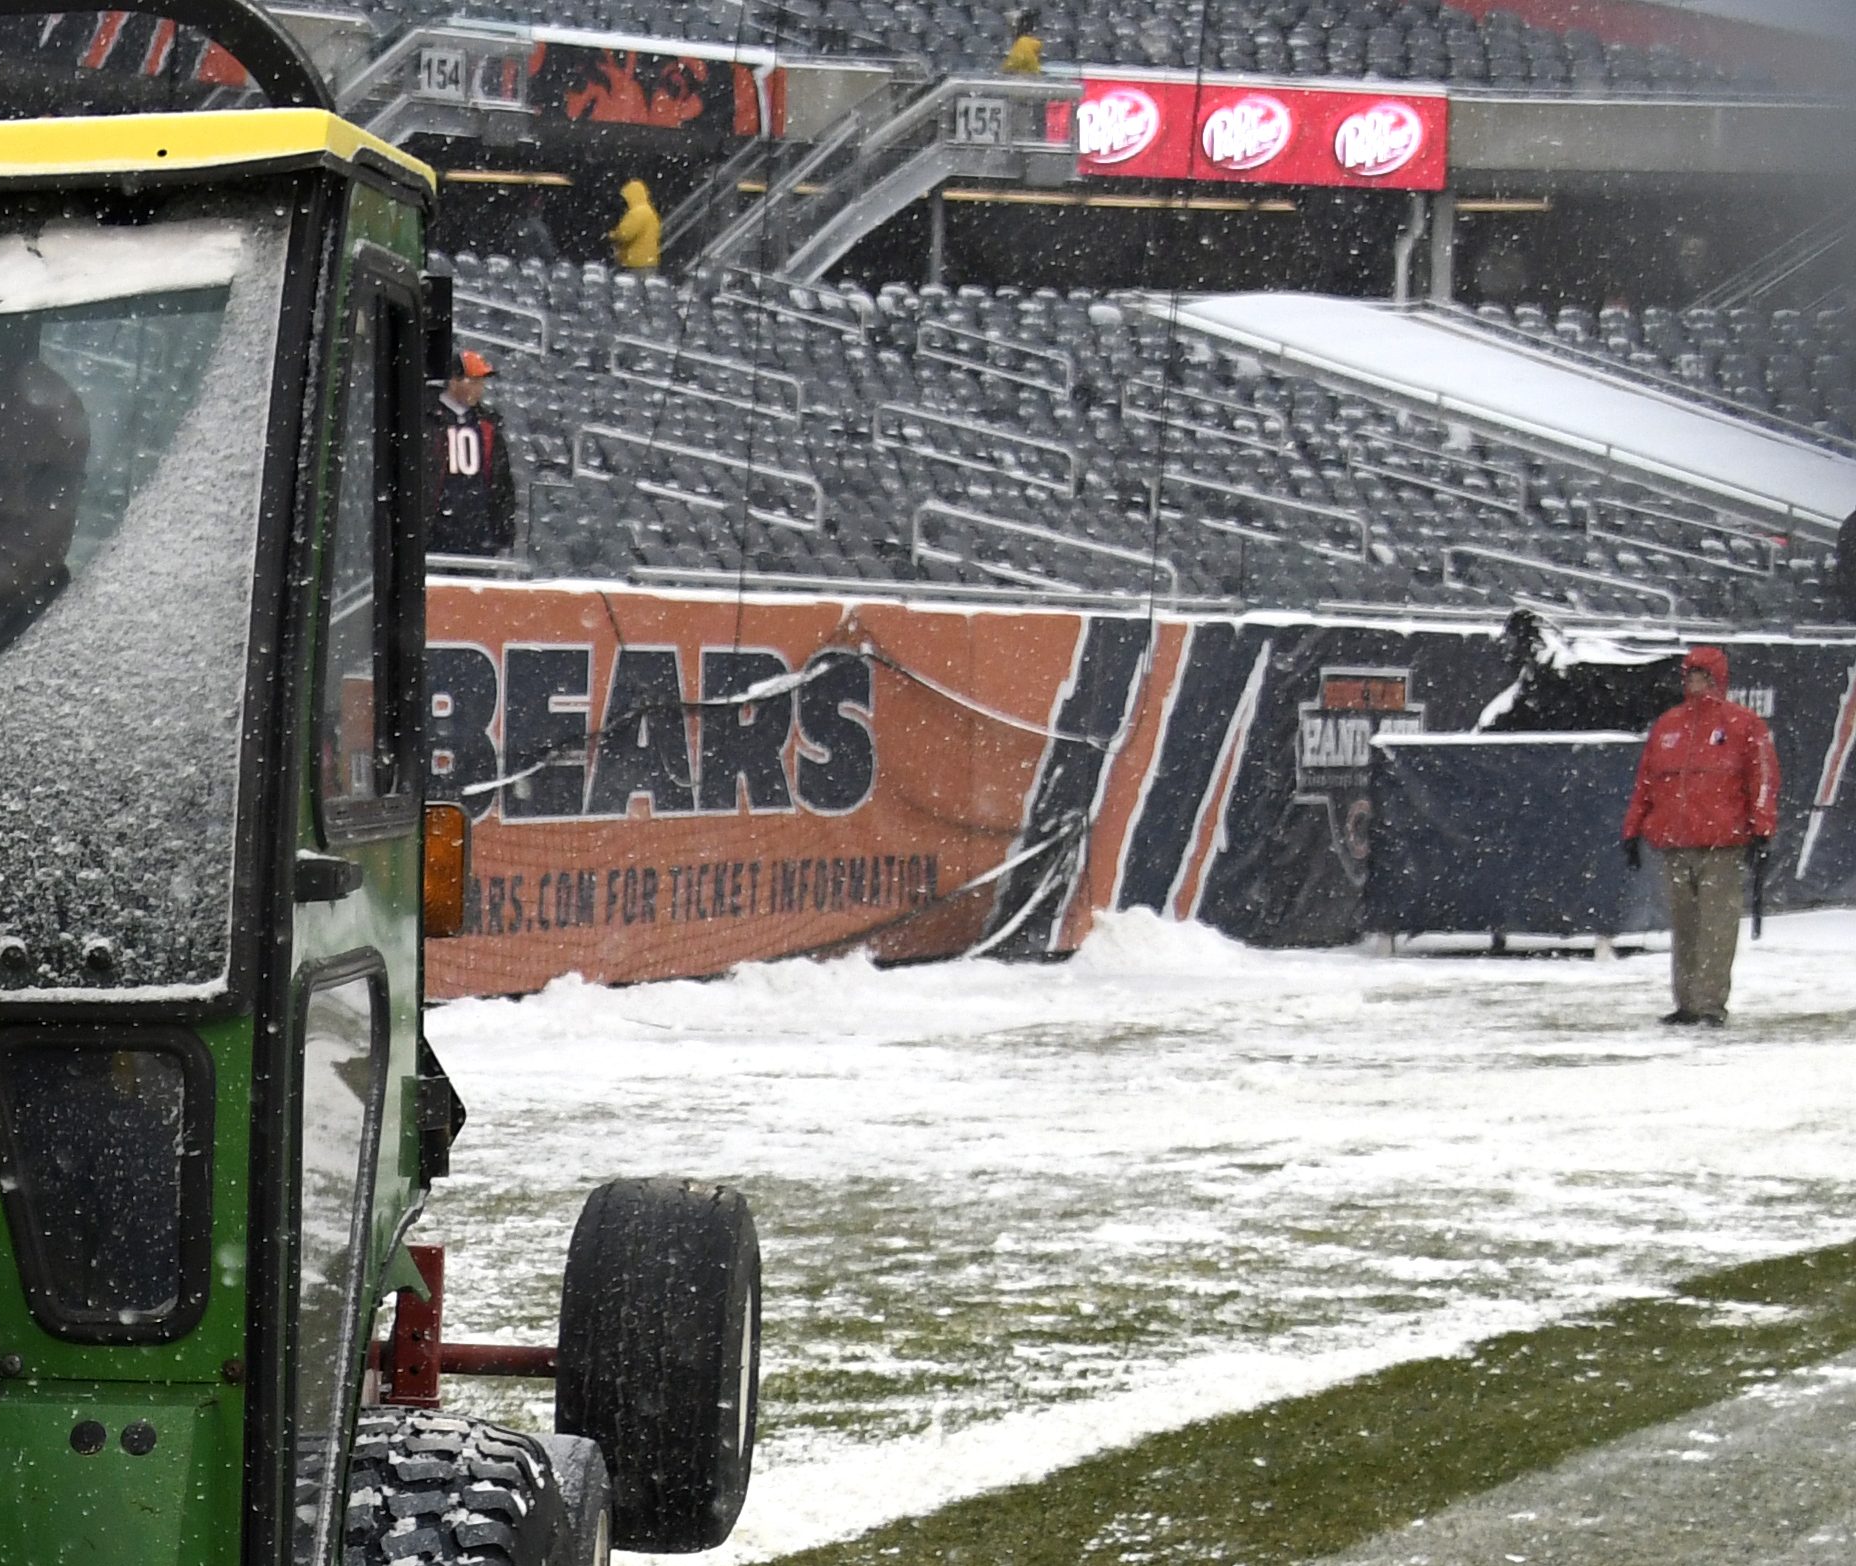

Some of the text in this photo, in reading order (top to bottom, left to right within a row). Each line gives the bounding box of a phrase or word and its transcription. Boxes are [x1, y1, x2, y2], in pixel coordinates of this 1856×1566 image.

[423, 58, 460, 91] 154
[447, 425, 480, 475] 10
[425, 640, 876, 825] BEARS
[463, 854, 938, 936] ARS.COM FOR TICKET INFORMATION
